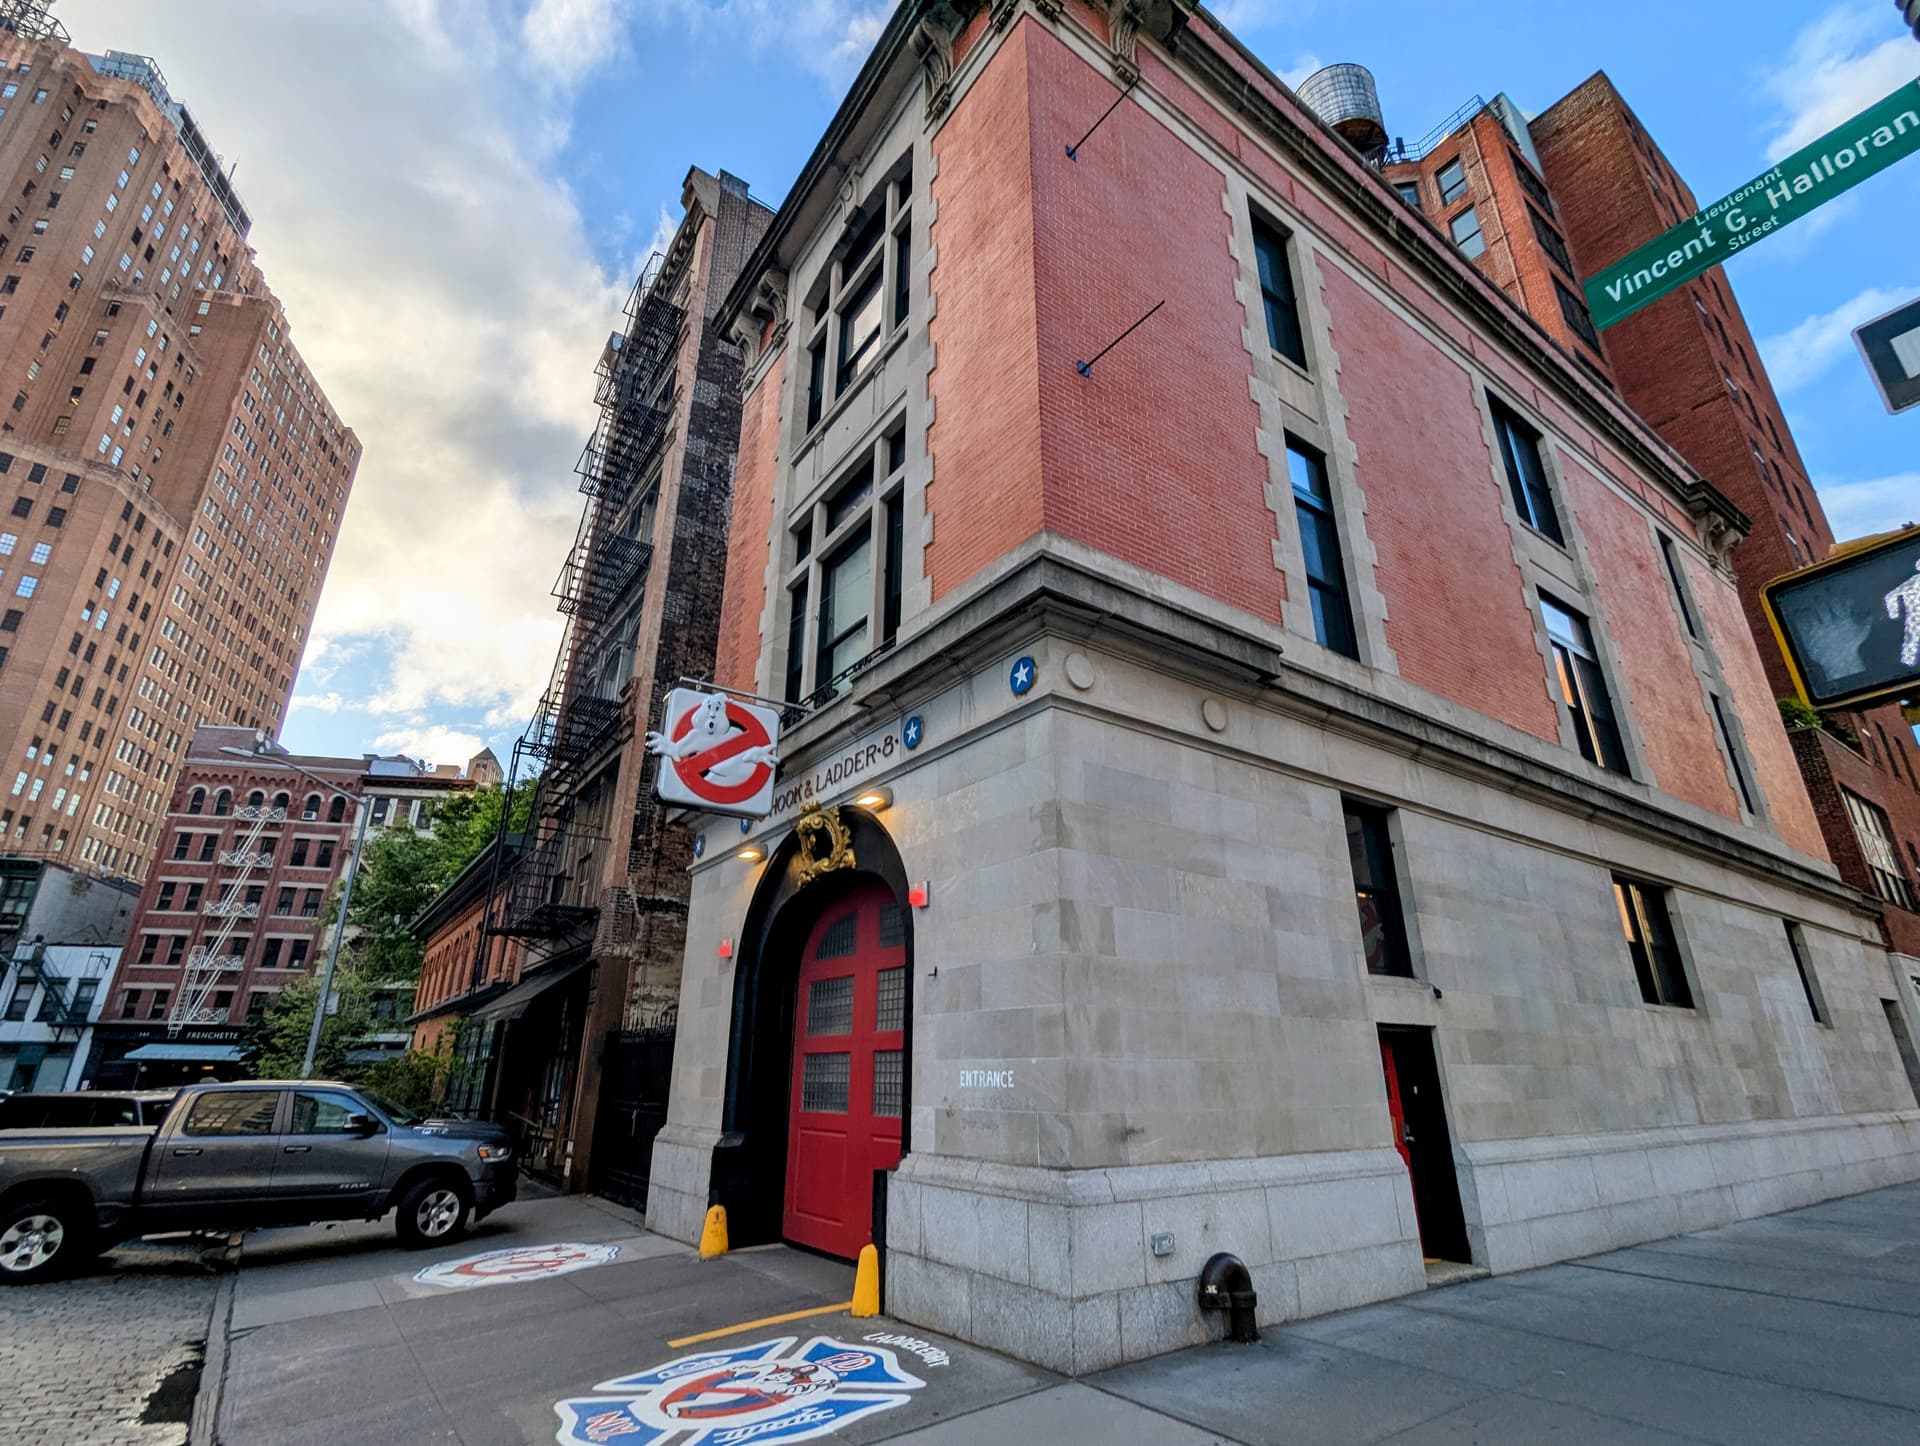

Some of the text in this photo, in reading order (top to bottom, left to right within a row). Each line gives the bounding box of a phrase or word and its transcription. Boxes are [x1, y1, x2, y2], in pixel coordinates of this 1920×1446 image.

[1604, 109, 1920, 303] Vincent G. Halloran
[1694, 166, 1783, 227] Lieutenant
[1727, 214, 1780, 251] Street
[769, 783, 803, 818] HOOK
[804, 779, 814, 799] &
[186, 1031, 239, 1040] FRENCHETTE
[960, 1070, 1014, 1088] ENTRANCE
